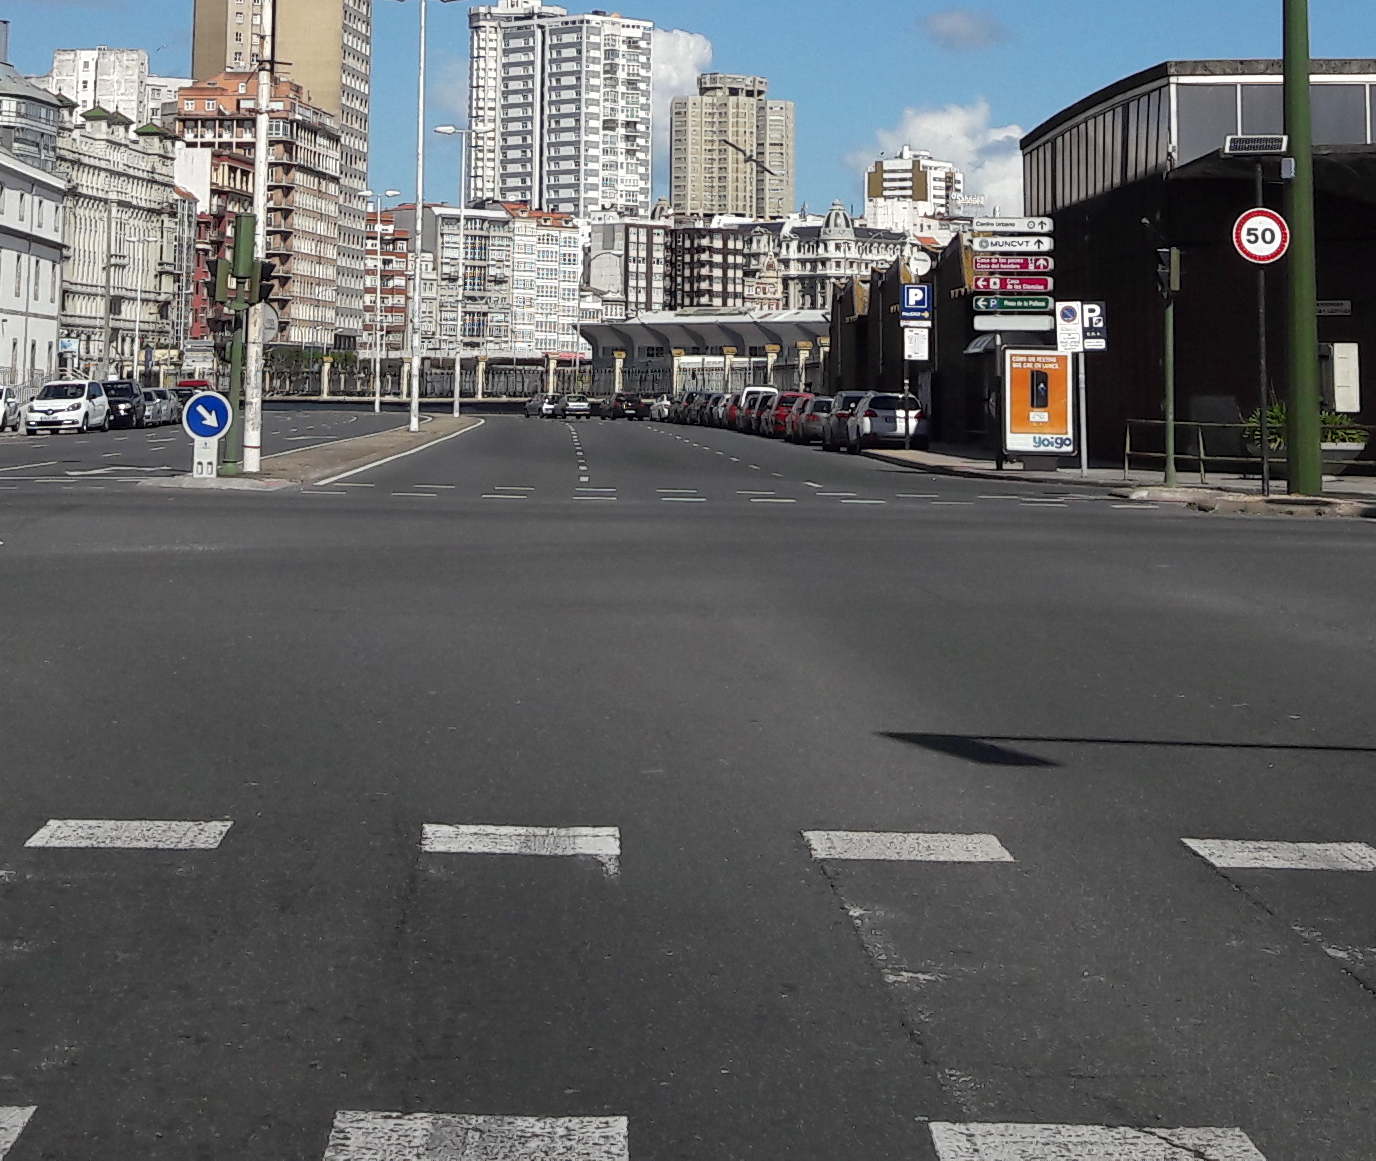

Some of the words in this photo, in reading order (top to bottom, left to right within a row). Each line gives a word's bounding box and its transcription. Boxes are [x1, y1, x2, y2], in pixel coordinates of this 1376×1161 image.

[1246, 228, 1276, 244] 50
[909, 289, 924, 306] P
[1083, 304, 1100, 327] P
[1033, 436, 1072, 448] yoigo
